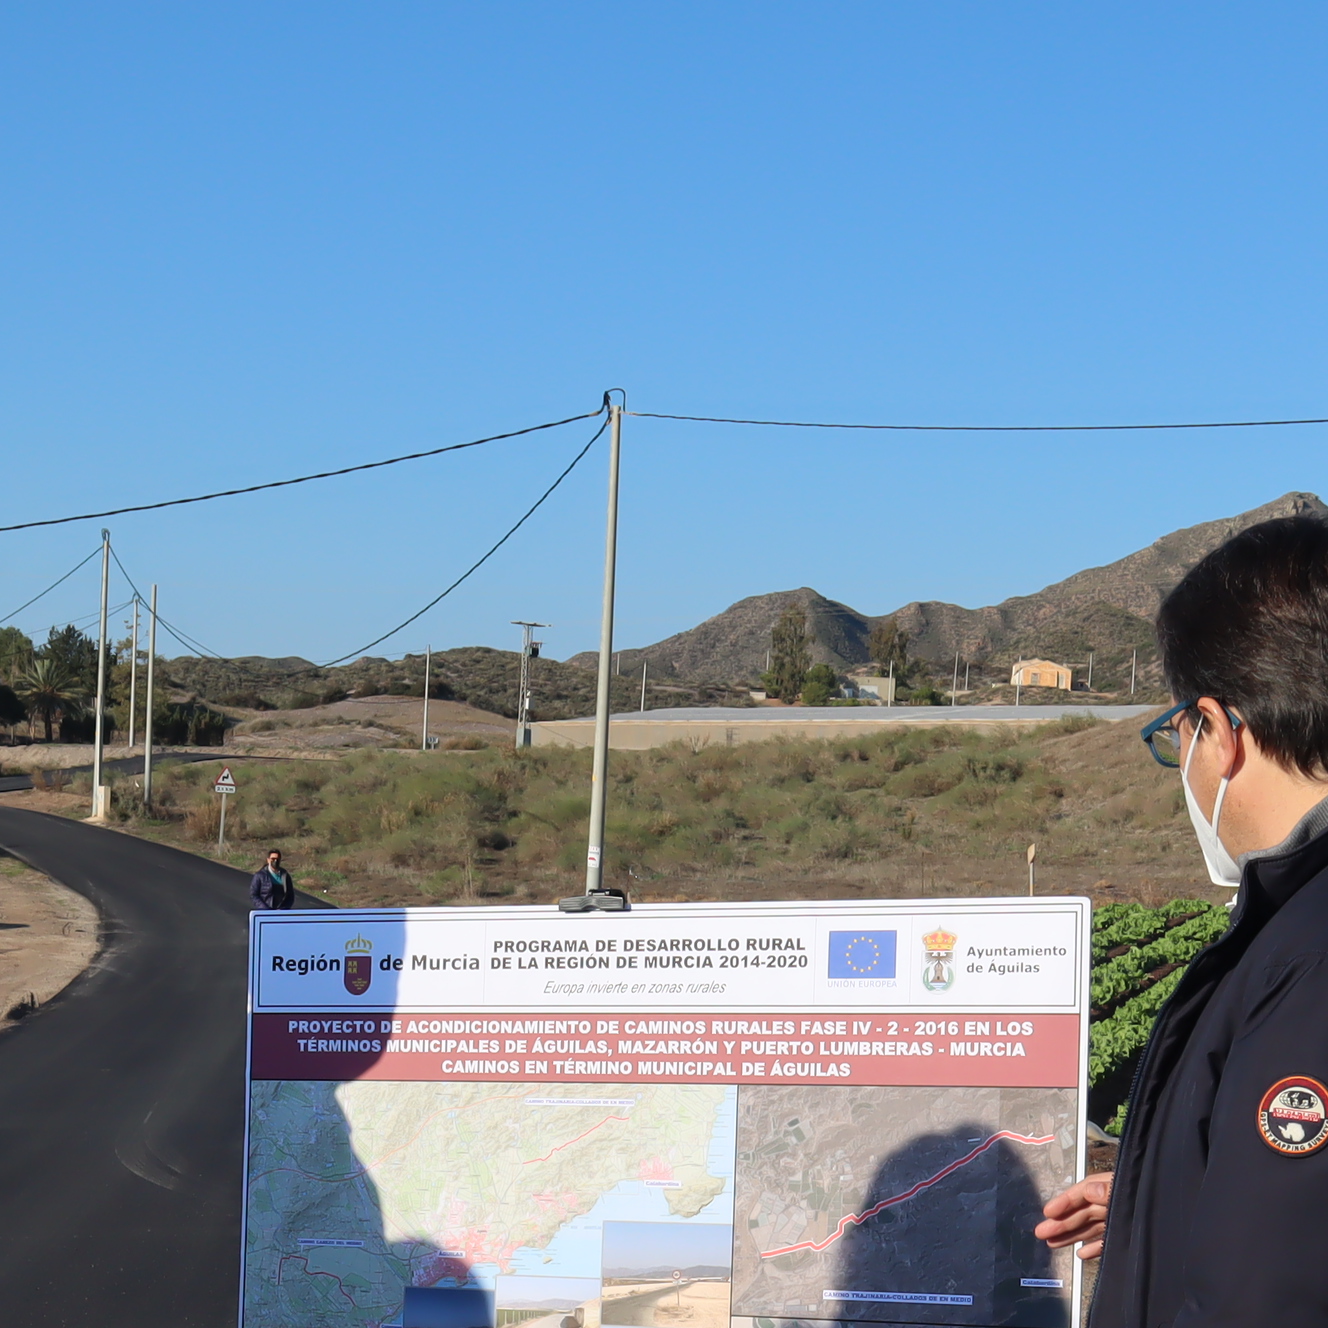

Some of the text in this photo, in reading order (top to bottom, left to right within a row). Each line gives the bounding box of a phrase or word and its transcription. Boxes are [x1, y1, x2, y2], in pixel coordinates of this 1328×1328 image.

[494, 938, 805, 953] PROGRAMA DE DESARROLLO RURAL
[967, 946, 1066, 960] Ayuntamiento
[272, 954, 479, 975] Región de Murcia
[491, 954, 807, 969] DE LA REGIÓN DE MURCIA 2014-2020
[967, 959, 1039, 975] de Águilas
[544, 981, 726, 996] Europa invierte en zonas rurales
[828, 979, 897, 988] UNIÓN EUROPEA
[289, 1021, 375, 1033] PROYECTO
[381, 1021, 401, 1033] DE
[407, 1021, 591, 1034] ACONDICIONAMIENTO
[597, 1021, 619, 1034] DE
[625, 1021, 705, 1034] CAMINOS
[712, 1021, 794, 1034] RURALES
[801, 1021, 846, 1035] FASE
[853, 1021, 871, 1035] IV
[887, 1021, 898, 1035] 2
[915, 1021, 958, 1035] 2016
[965, 1021, 989, 1035] EN
[997, 1022, 1033, 1035] LOS
[297, 1037, 381, 1052] TÉRMINOS
[384, 1040, 499, 1054] MUNICIPALES
[505, 1040, 527, 1053] DE
[532, 1037, 612, 1056] ÁGUILAS,
[618, 1038, 717, 1054] MAZARRÓN
[723, 1041, 735, 1054] Y
[741, 1041, 813, 1055] PUERTO
[820, 1042, 933, 1055] LUMBRERAS
[950, 1042, 1025, 1056] MURCIA
[442, 1058, 850, 1076] CAMINOS EN TÉRMINO MUNICIPAL DE ÁGUILAS
[1272, 1137, 1306, 1151] MAPPING
